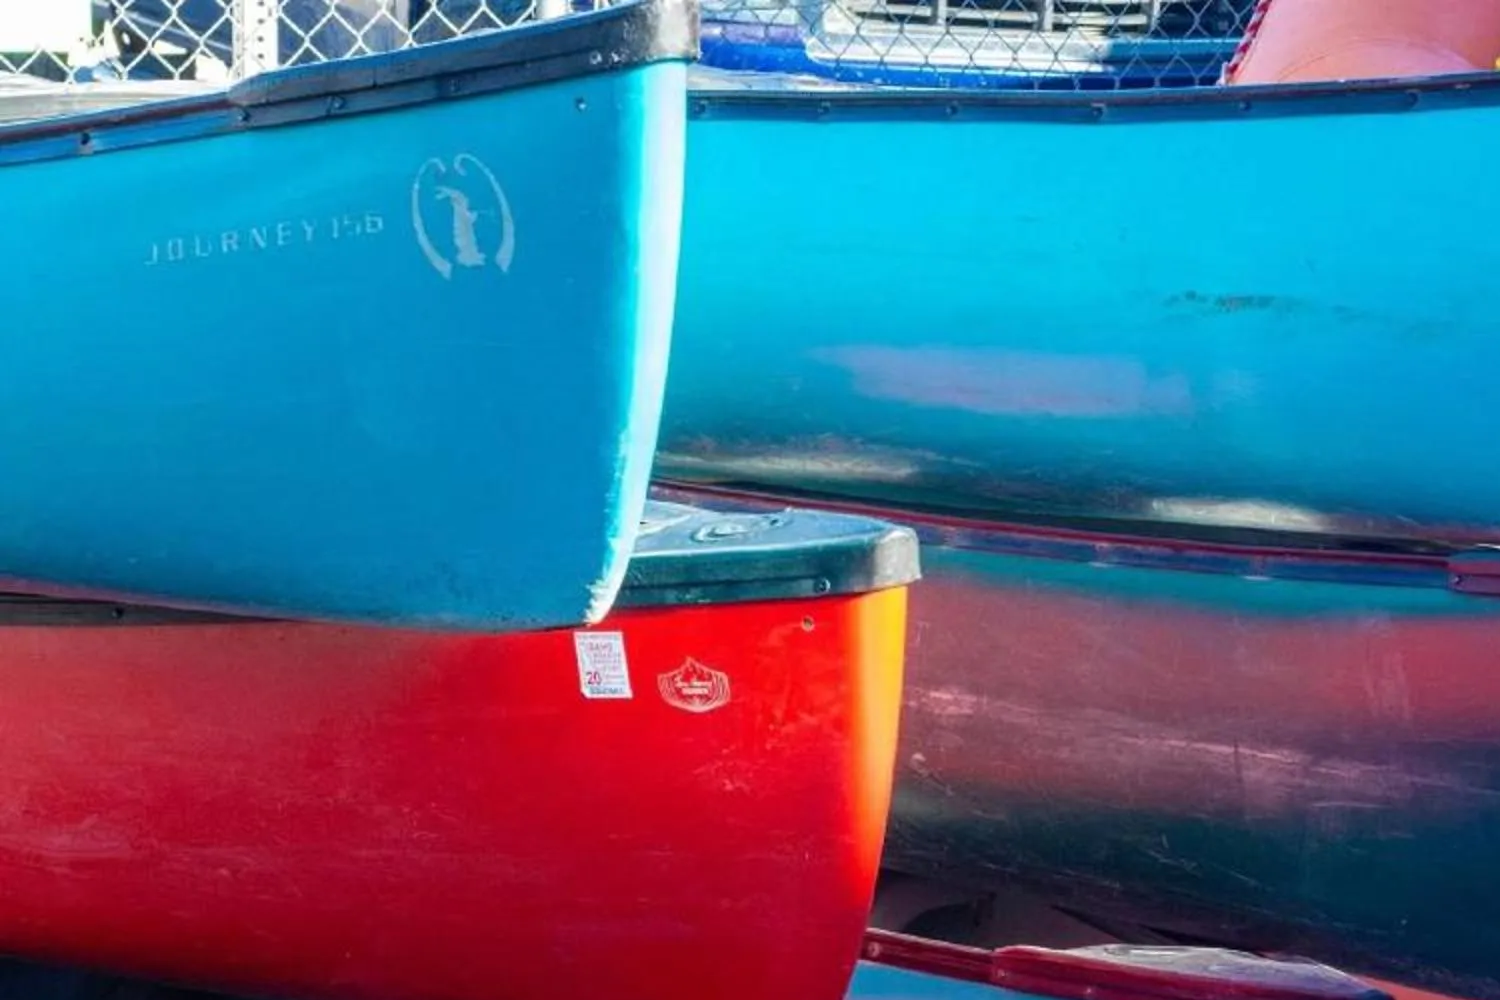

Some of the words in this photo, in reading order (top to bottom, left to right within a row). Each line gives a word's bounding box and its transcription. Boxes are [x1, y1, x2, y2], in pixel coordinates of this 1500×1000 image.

[144, 217, 316, 266] JOURNEY
[329, 210, 384, 240] 156
[585, 670, 603, 686] 20
